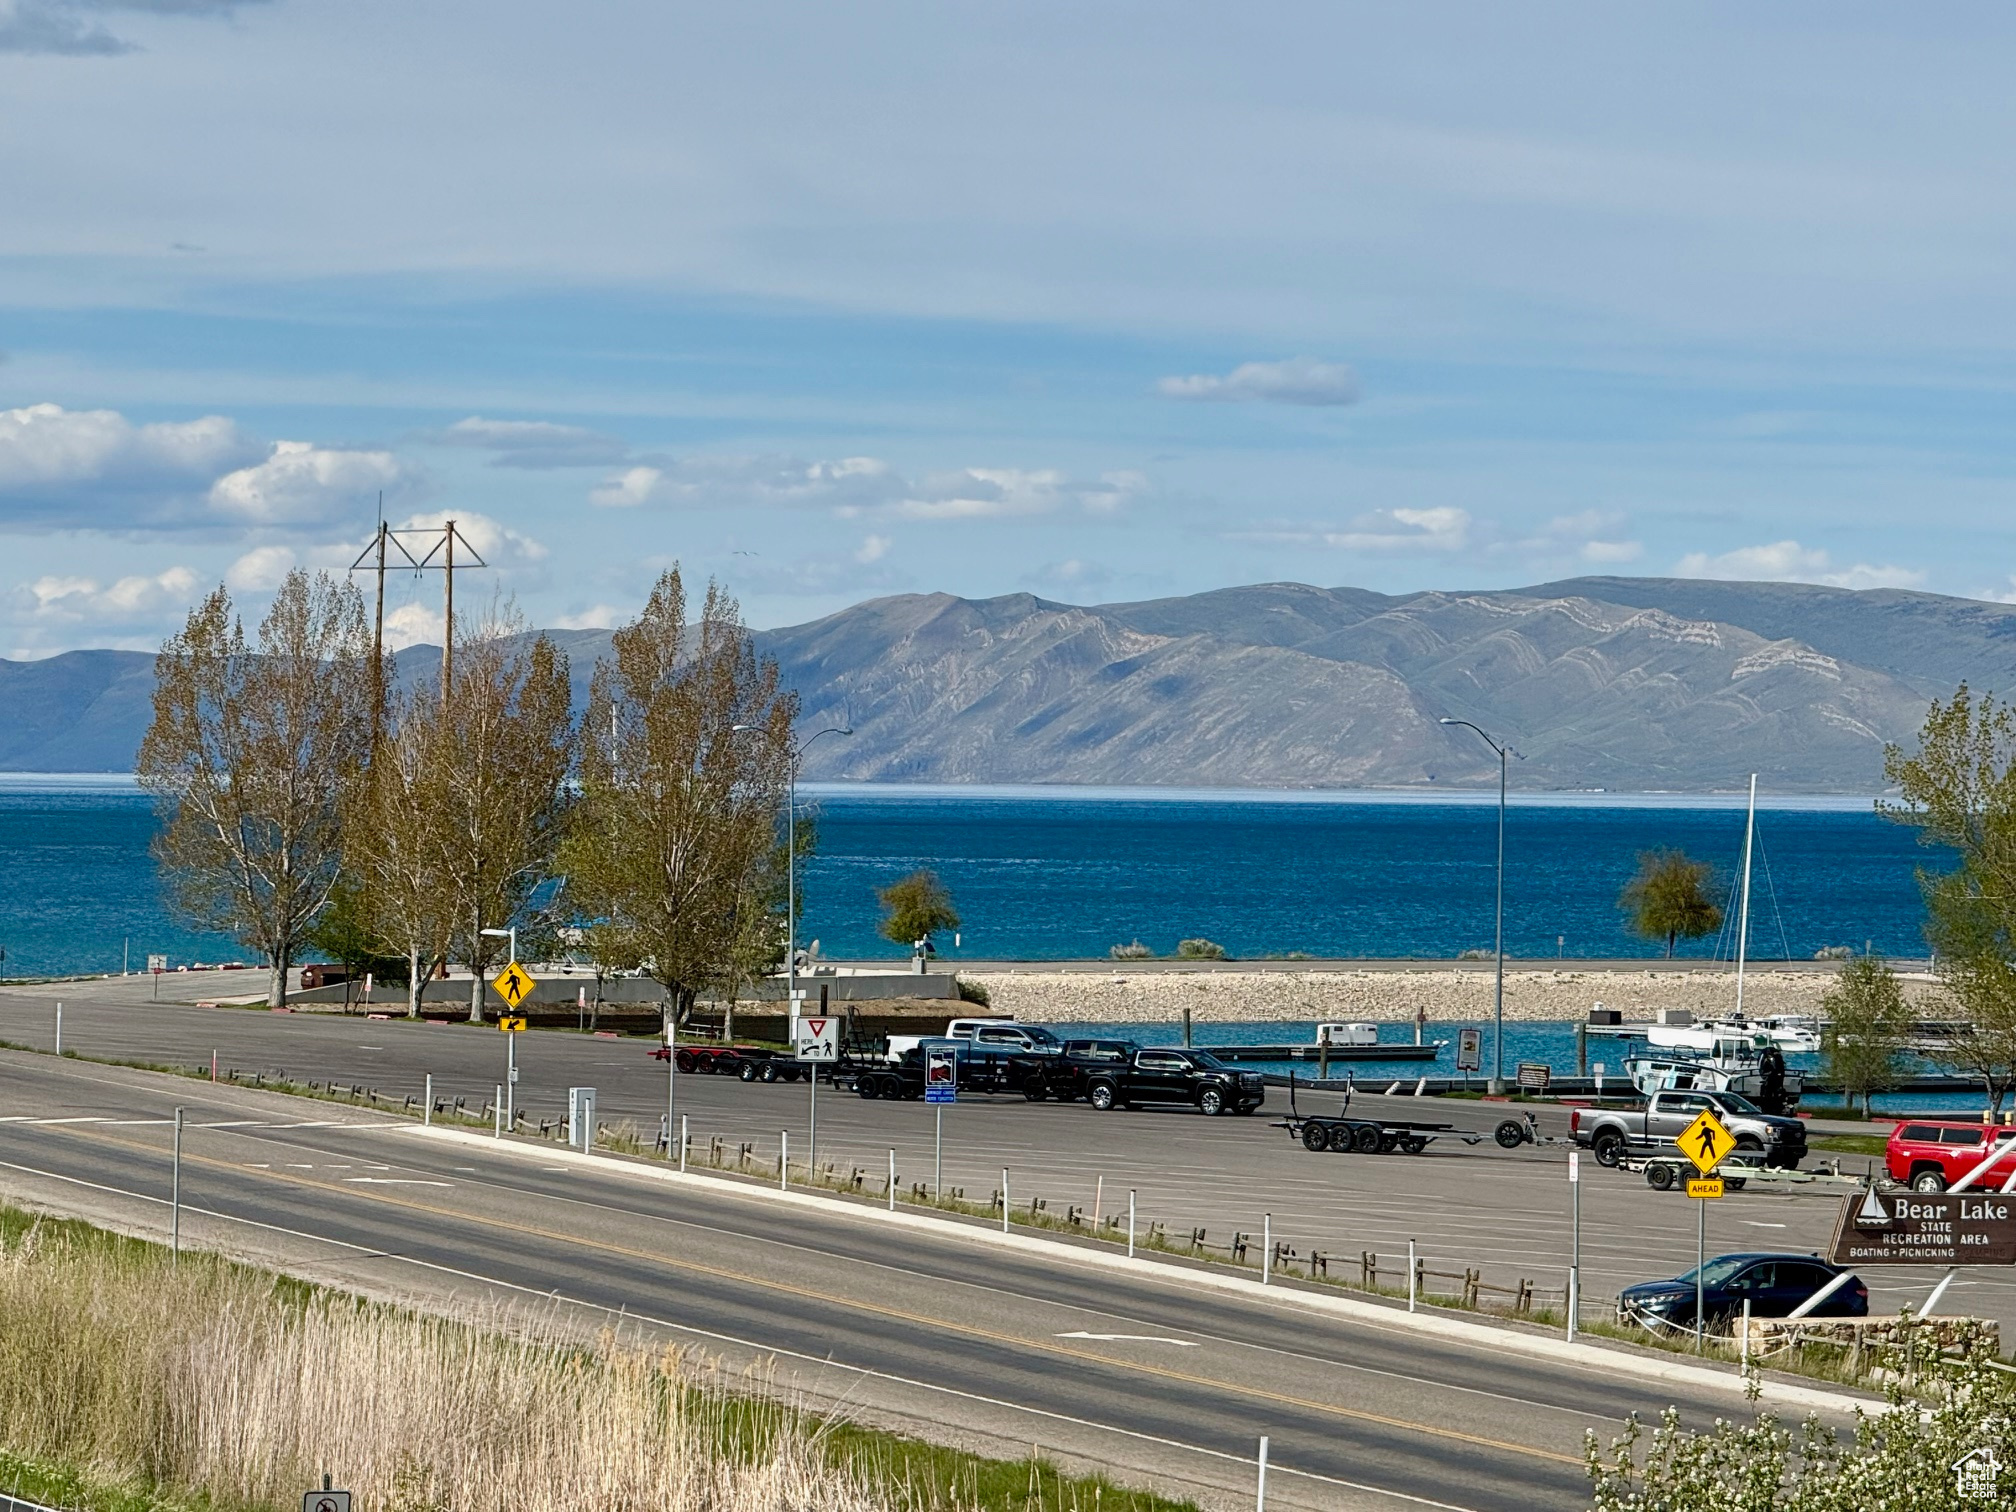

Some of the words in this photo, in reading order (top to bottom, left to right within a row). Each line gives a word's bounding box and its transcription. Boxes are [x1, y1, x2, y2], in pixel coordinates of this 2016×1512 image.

[1692, 1185, 1719, 1193] AHEAD
[1895, 1199, 1948, 1219] Bear
[1960, 1199, 2008, 1220] Lake
[1920, 1221, 1952, 1233] STATE
[1882, 1233, 1951, 1245] RECREATION
[1960, 1234, 1989, 1245] AREA
[1849, 1247, 1890, 1257] BOATING
[1899, 1248, 1955, 1258] PICNICKING
